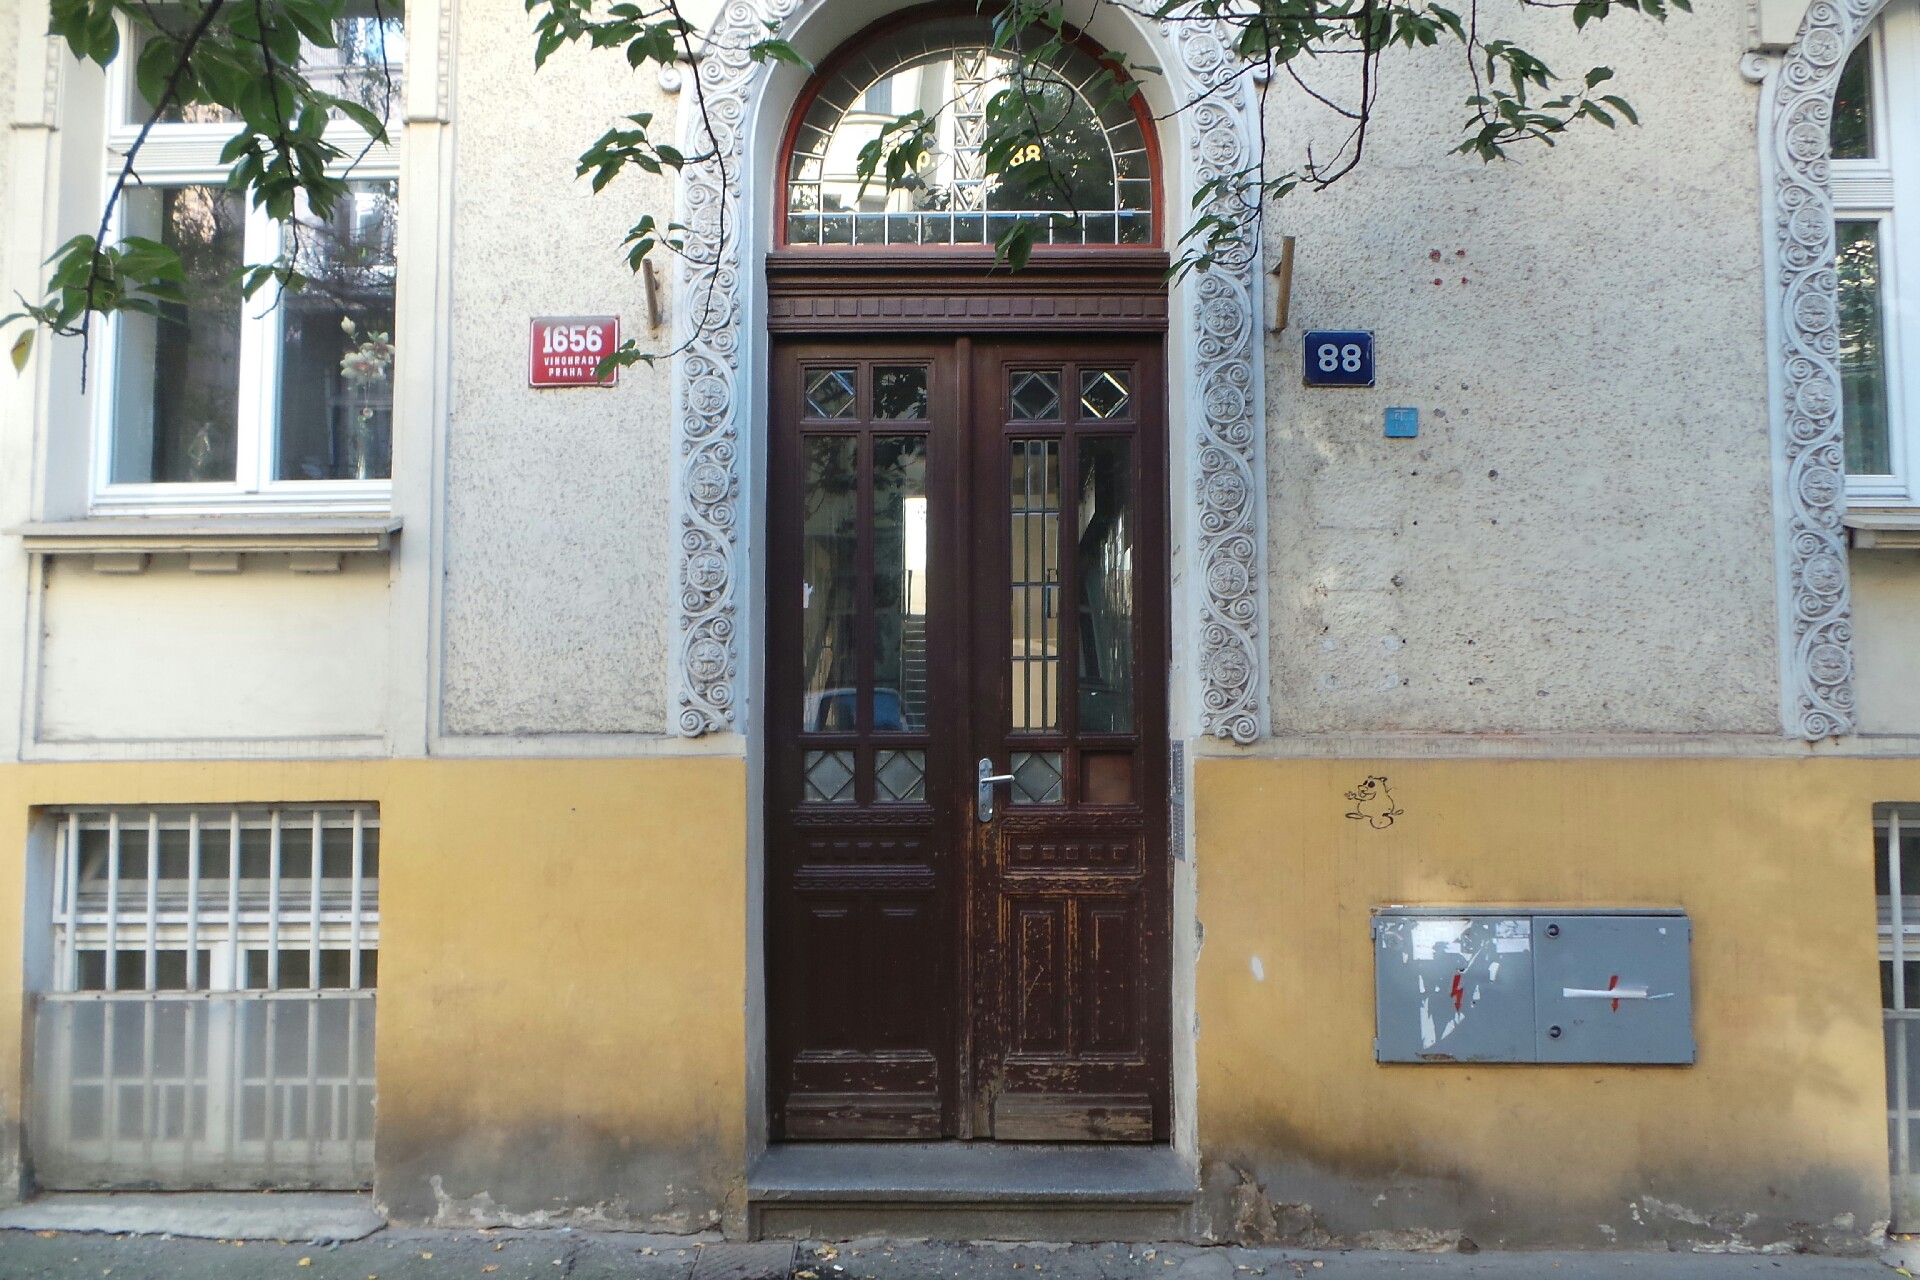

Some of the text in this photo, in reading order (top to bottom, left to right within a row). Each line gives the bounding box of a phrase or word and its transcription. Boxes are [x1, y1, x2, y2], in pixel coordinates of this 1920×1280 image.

[543, 325, 602, 353] 1656
[544, 356, 600, 366] VINOHRADY
[1317, 343, 1362, 372] 88
[548, 367, 583, 377] PRAHA
